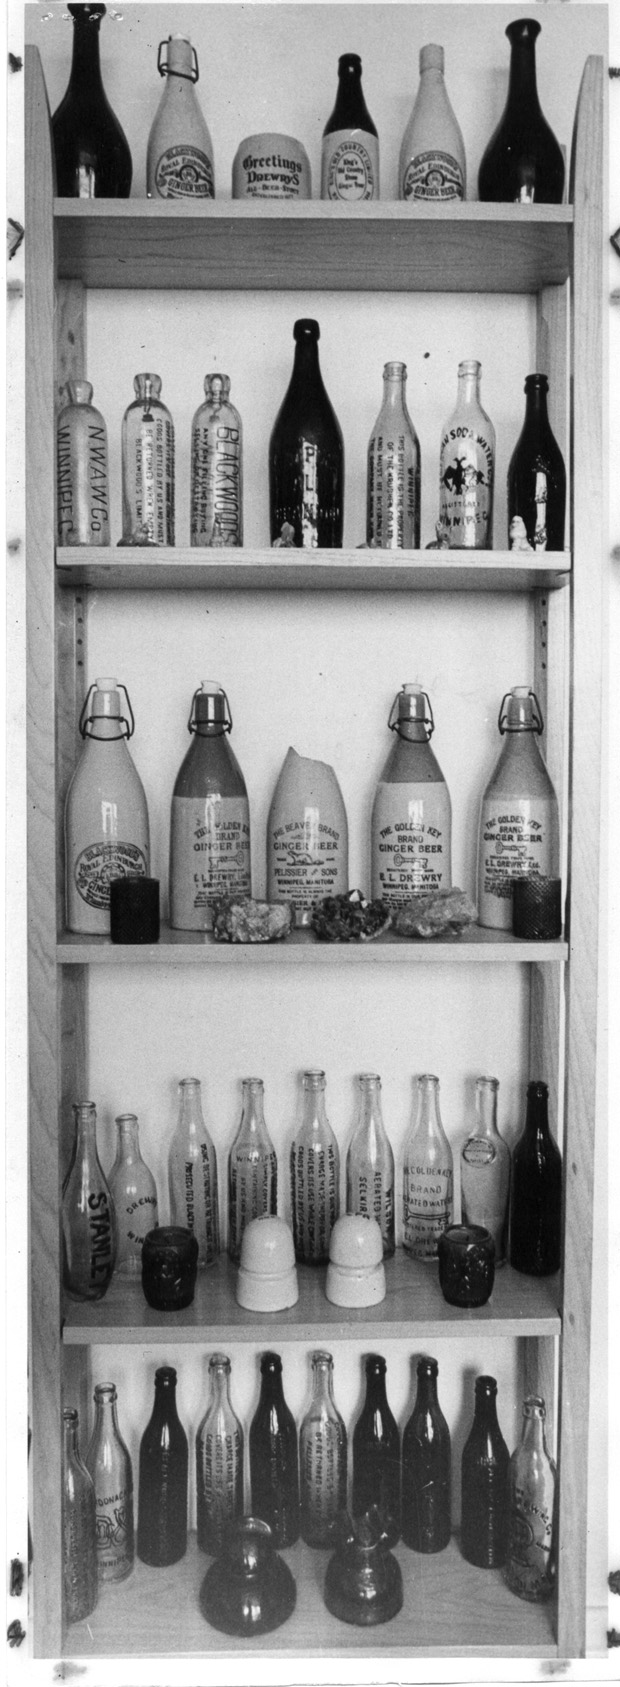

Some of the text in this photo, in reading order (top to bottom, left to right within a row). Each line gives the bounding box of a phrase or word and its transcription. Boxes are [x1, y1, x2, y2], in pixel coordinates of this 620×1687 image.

[242, 154, 302, 173] Greetings
[247, 170, 300, 186] DREWRYS
[158, 493, 163, 504] US
[486, 818, 496, 830] THE
[273, 828, 285, 840] THE
[285, 822, 311, 833] BEAVE
[318, 824, 340, 840] BRAND
[380, 823, 442, 839] THE GOLDEN KEY
[500, 826, 524, 834] BRAND
[398, 835, 424, 844] BRAND
[484, 832, 542, 842] GINGER BEER
[194, 842, 232, 852] GINGER
[274, 842, 310, 850] GINGER
[379, 844, 442, 853] GINGER BEER
[274, 868, 338, 876] PELISSIER SONS
[400, 873, 442, 882] DREWRY
[88, 880, 110, 895] GINGE
[359, 1176, 368, 1213] SELKIR
[374, 1171, 382, 1212] AERATED
[410, 1184, 442, 1194] BRAND
[186, 1204, 194, 1229] BLACKW
[100, 1556, 125, 1568] INNIPE
